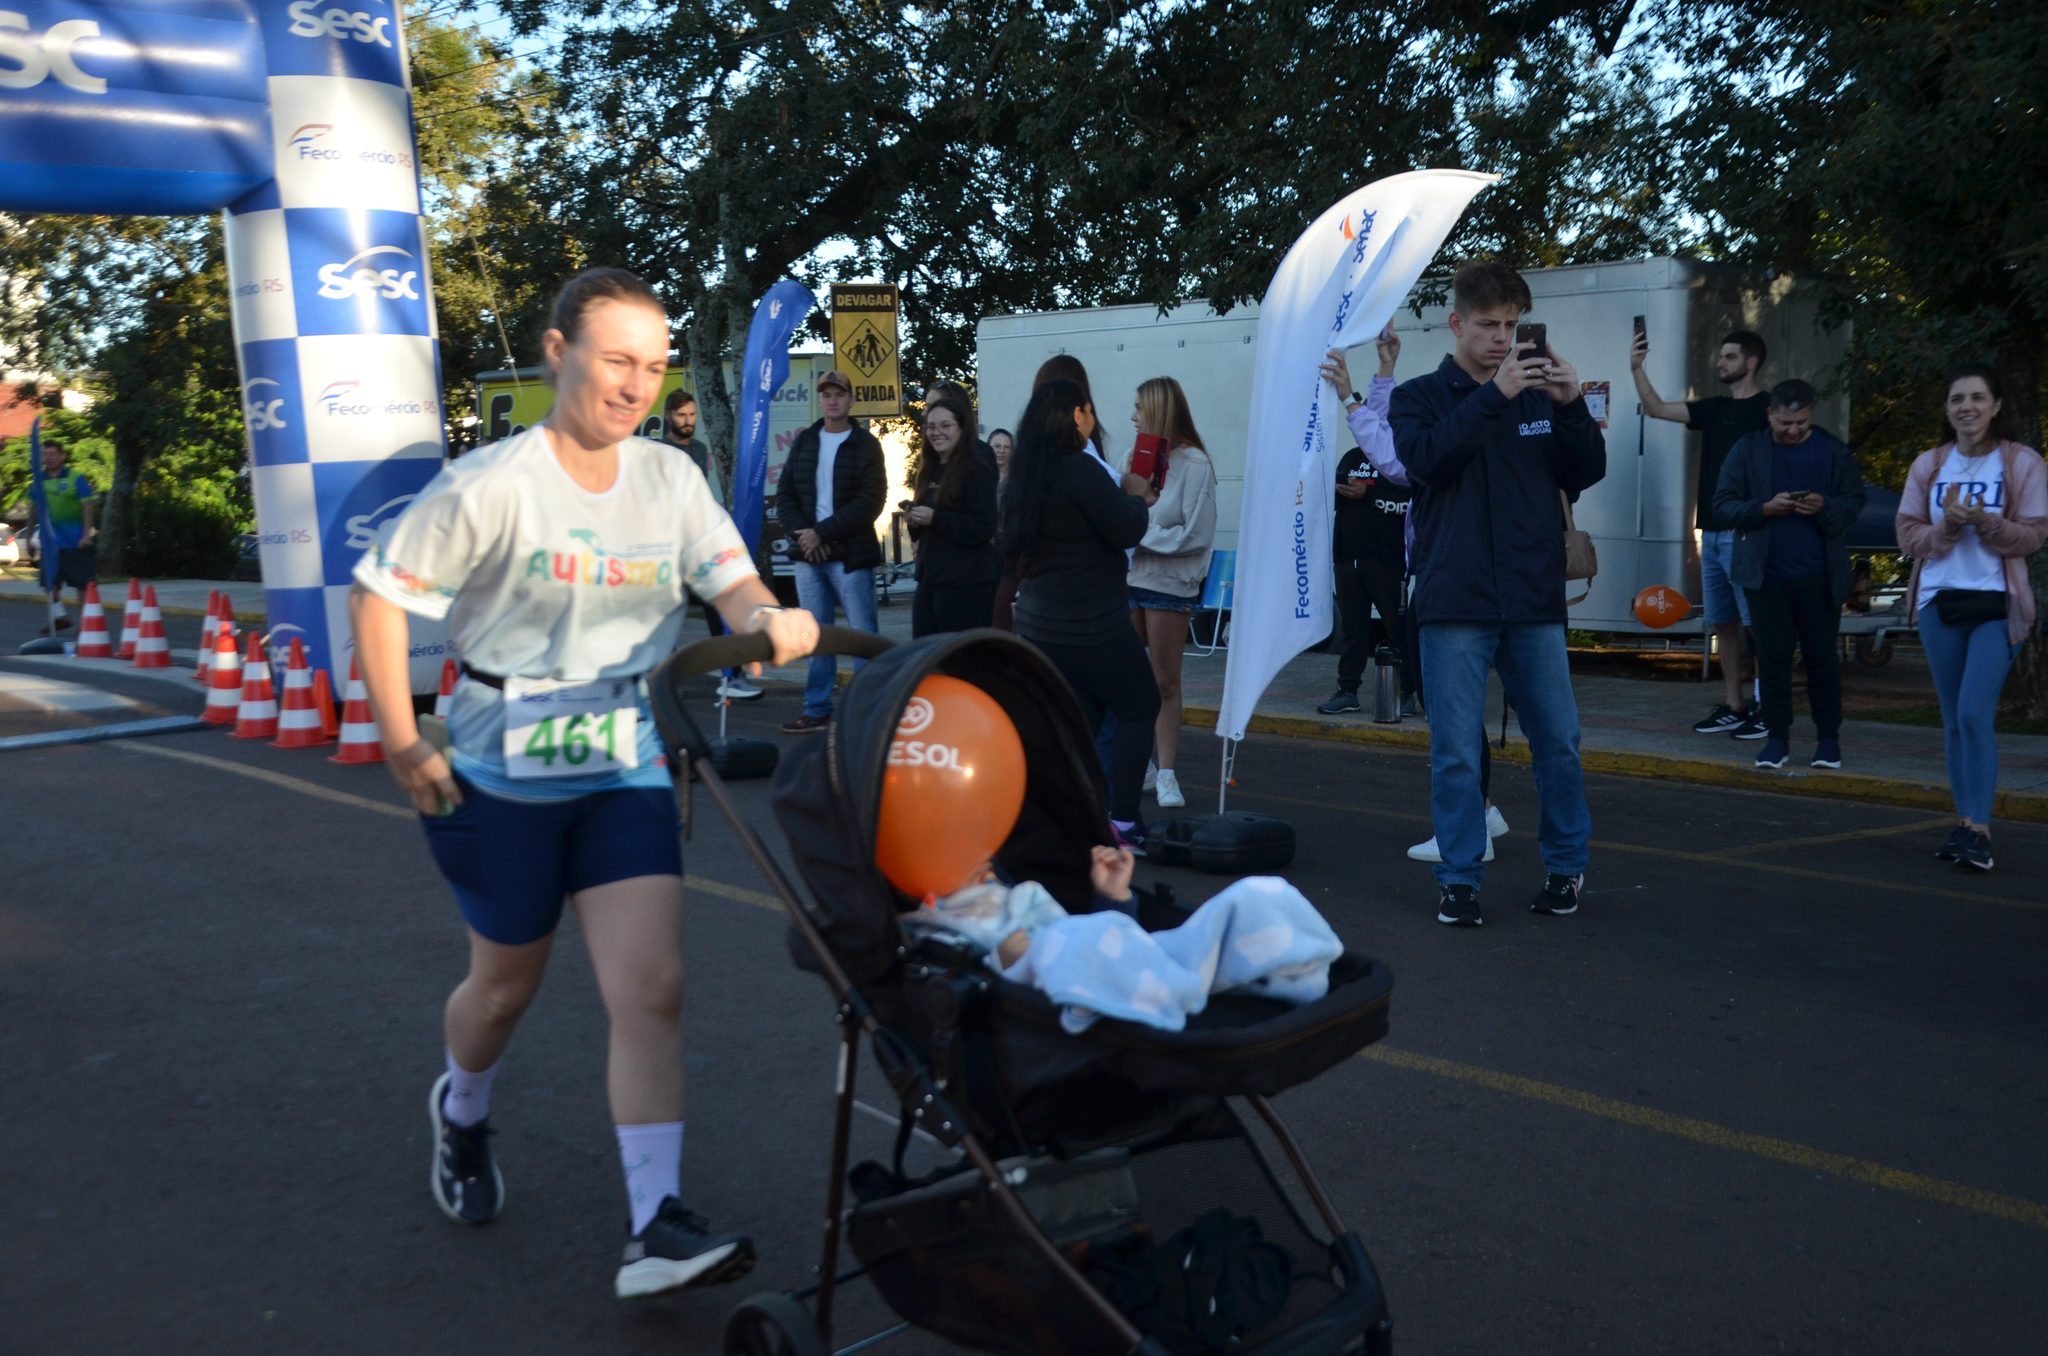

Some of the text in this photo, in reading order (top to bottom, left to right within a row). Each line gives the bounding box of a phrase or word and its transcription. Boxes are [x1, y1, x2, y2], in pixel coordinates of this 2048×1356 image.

[288, 0, 393, 48] Sesc
[299, 145, 396, 165] Fecoércio
[264, 277, 284, 293] RS
[318, 246, 419, 300] Sesc
[836, 294, 892, 306] DEVAGAR
[328, 401, 420, 416] Fecoércio
[291, 529, 311, 544] RS
[526, 547, 672, 587] Autismo
[1292, 511, 1310, 619] Fecomércio
[525, 711, 616, 767] 461
[887, 741, 963, 772] ESOL
